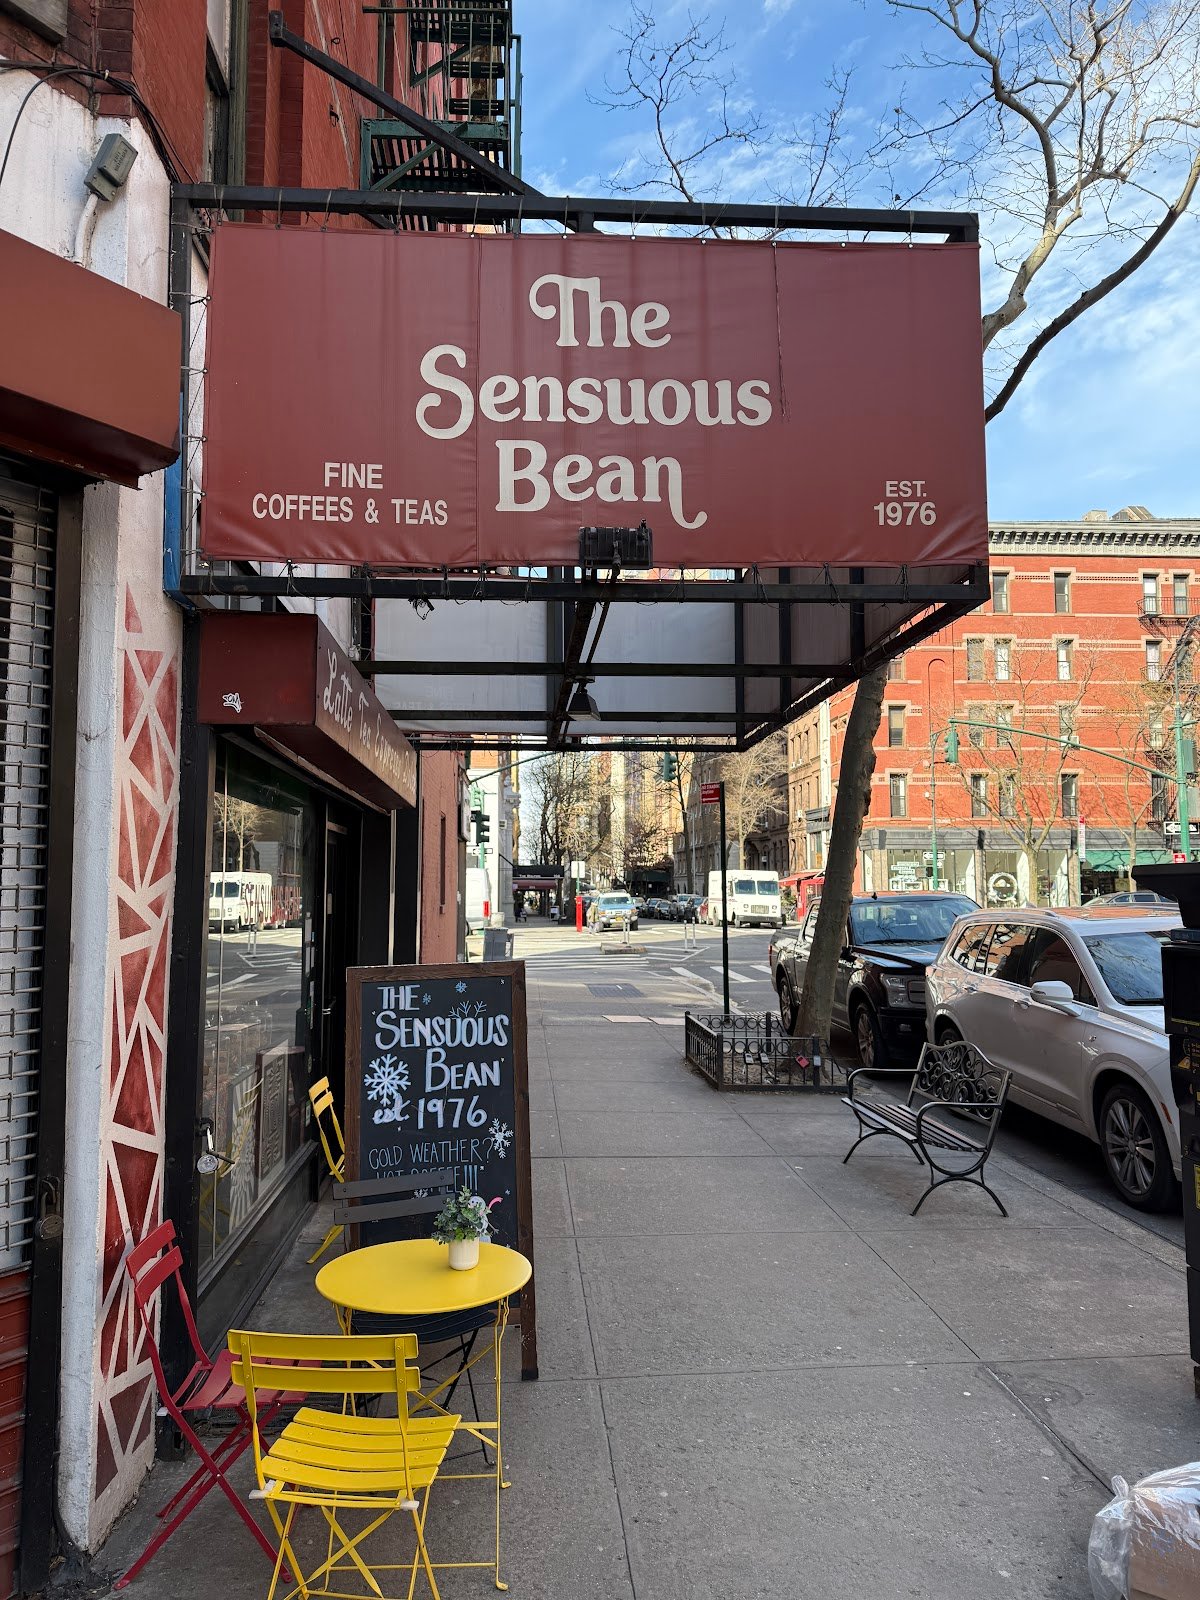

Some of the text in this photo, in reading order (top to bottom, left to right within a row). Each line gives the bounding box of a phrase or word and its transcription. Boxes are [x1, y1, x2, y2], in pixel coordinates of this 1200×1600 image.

[529, 273, 672, 348] The
[415, 344, 773, 440] Sensuous
[324, 462, 384, 489] FINE
[495, 439, 708, 529] Bean
[885, 480, 927, 498] EST.
[252, 493, 449, 526] COFFEES & TEAS
[873, 501, 937, 526] 1976
[323, 648, 354, 733] Latte
[358, 691, 372, 750] Tea
[377, 984, 421, 1011] THE
[375, 1010, 510, 1050] SENSUOUS
[425, 1047, 501, 1093] BEAN
[417, 1095, 488, 1130] 1976
[368, 1138, 495, 1170] COLD WEATHER?
